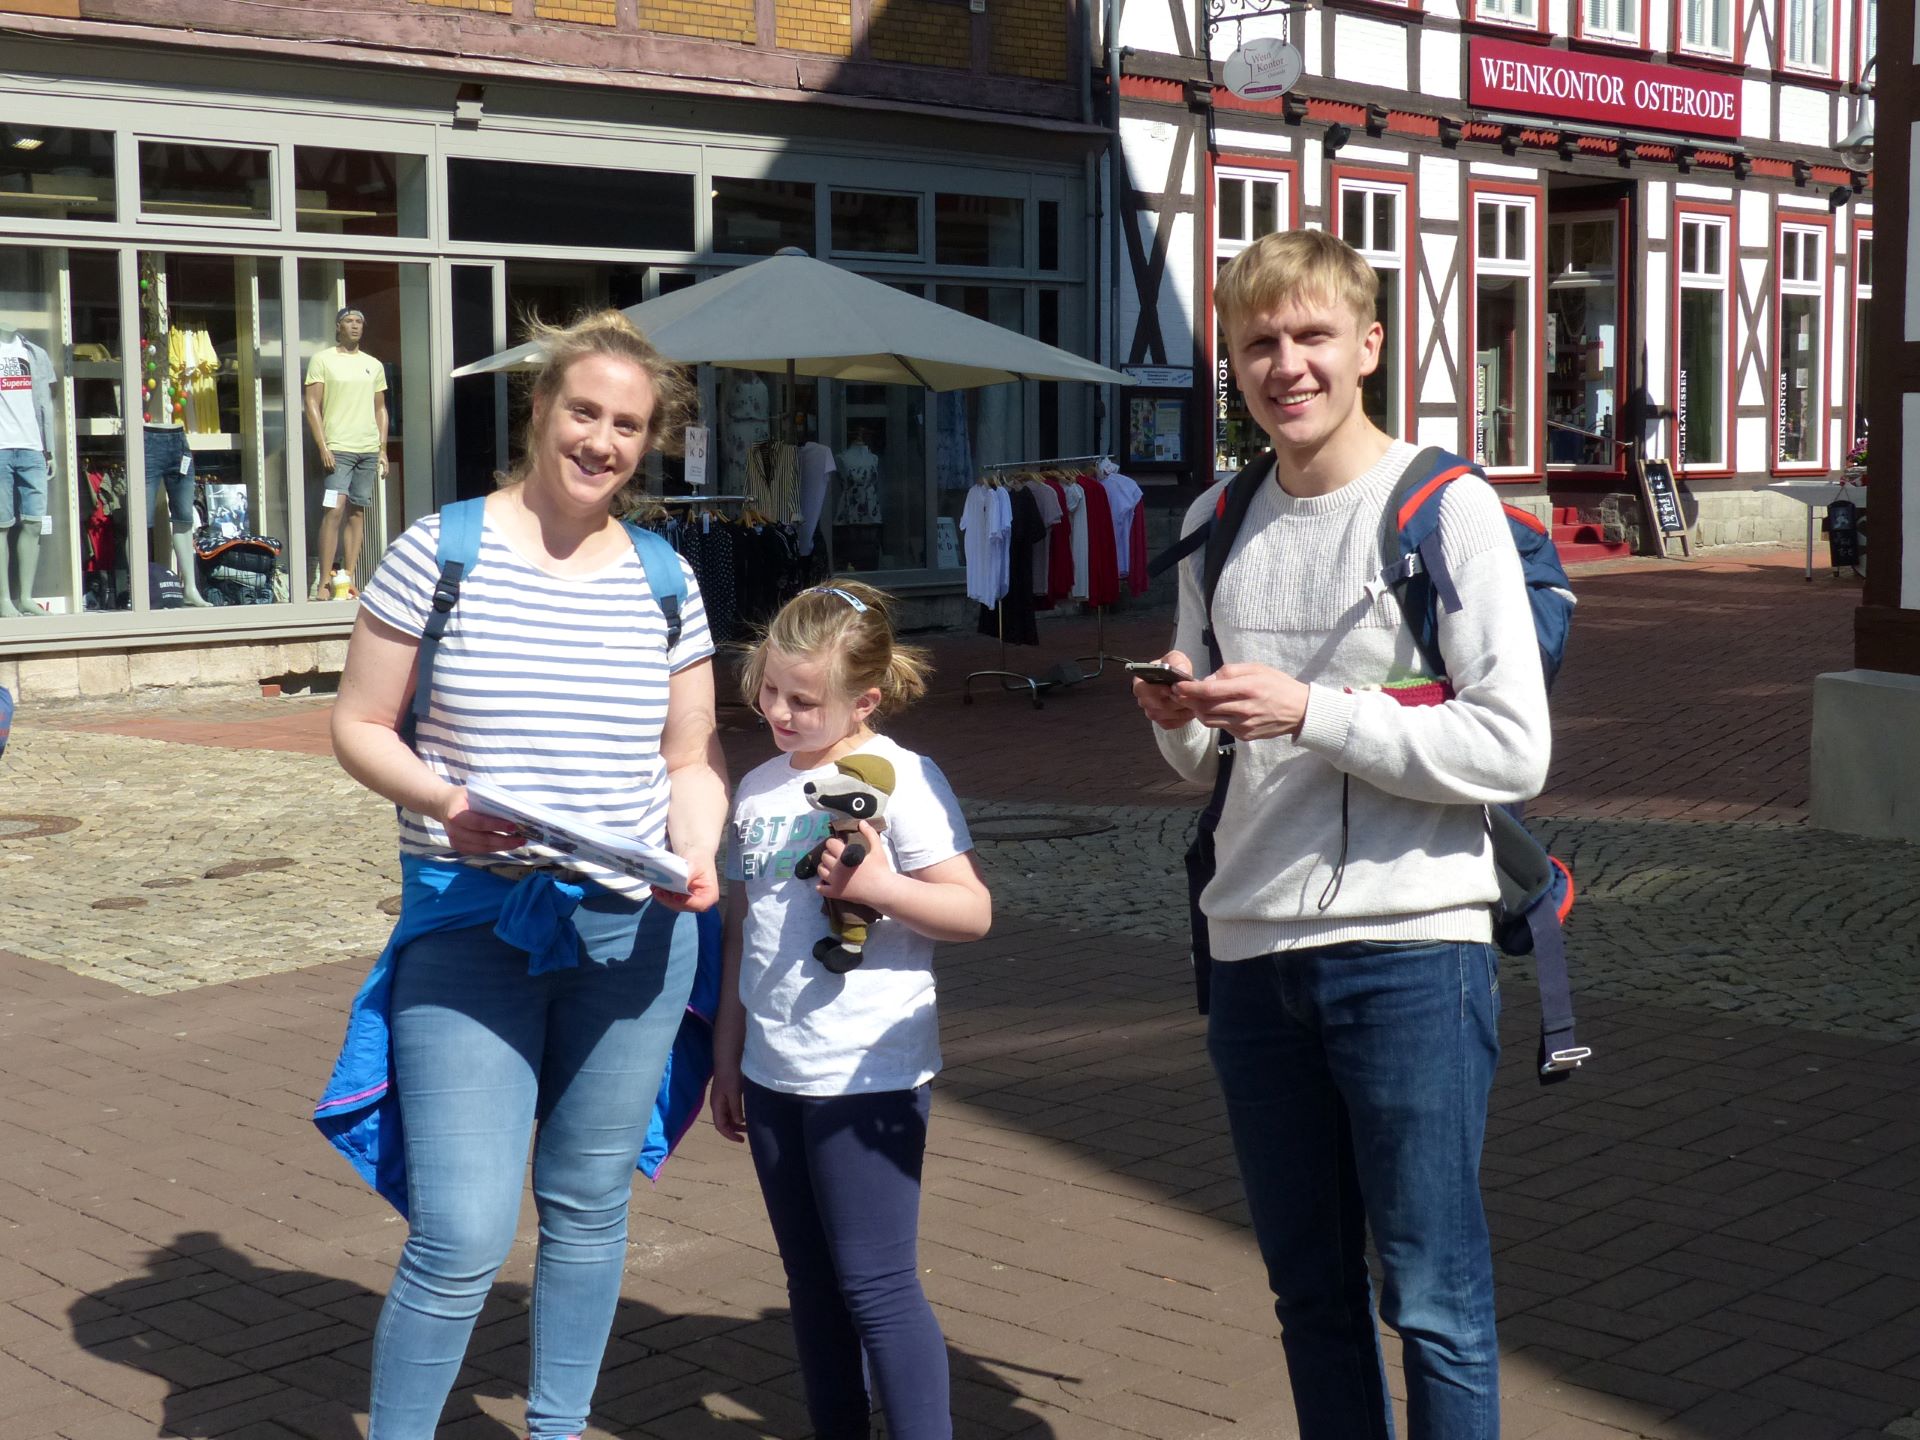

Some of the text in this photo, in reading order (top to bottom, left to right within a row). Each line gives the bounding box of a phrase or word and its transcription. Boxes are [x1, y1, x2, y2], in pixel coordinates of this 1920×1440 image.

[1246, 52, 1272, 64] Wein
[1256, 57, 1285, 73] Kontor
[1480, 57, 1735, 121] WEINKONTOR OSTERODE
[1779, 373, 1787, 458] WEINKONTOR
[734, 813, 832, 846] EST DA
[742, 847, 804, 881] EVE
